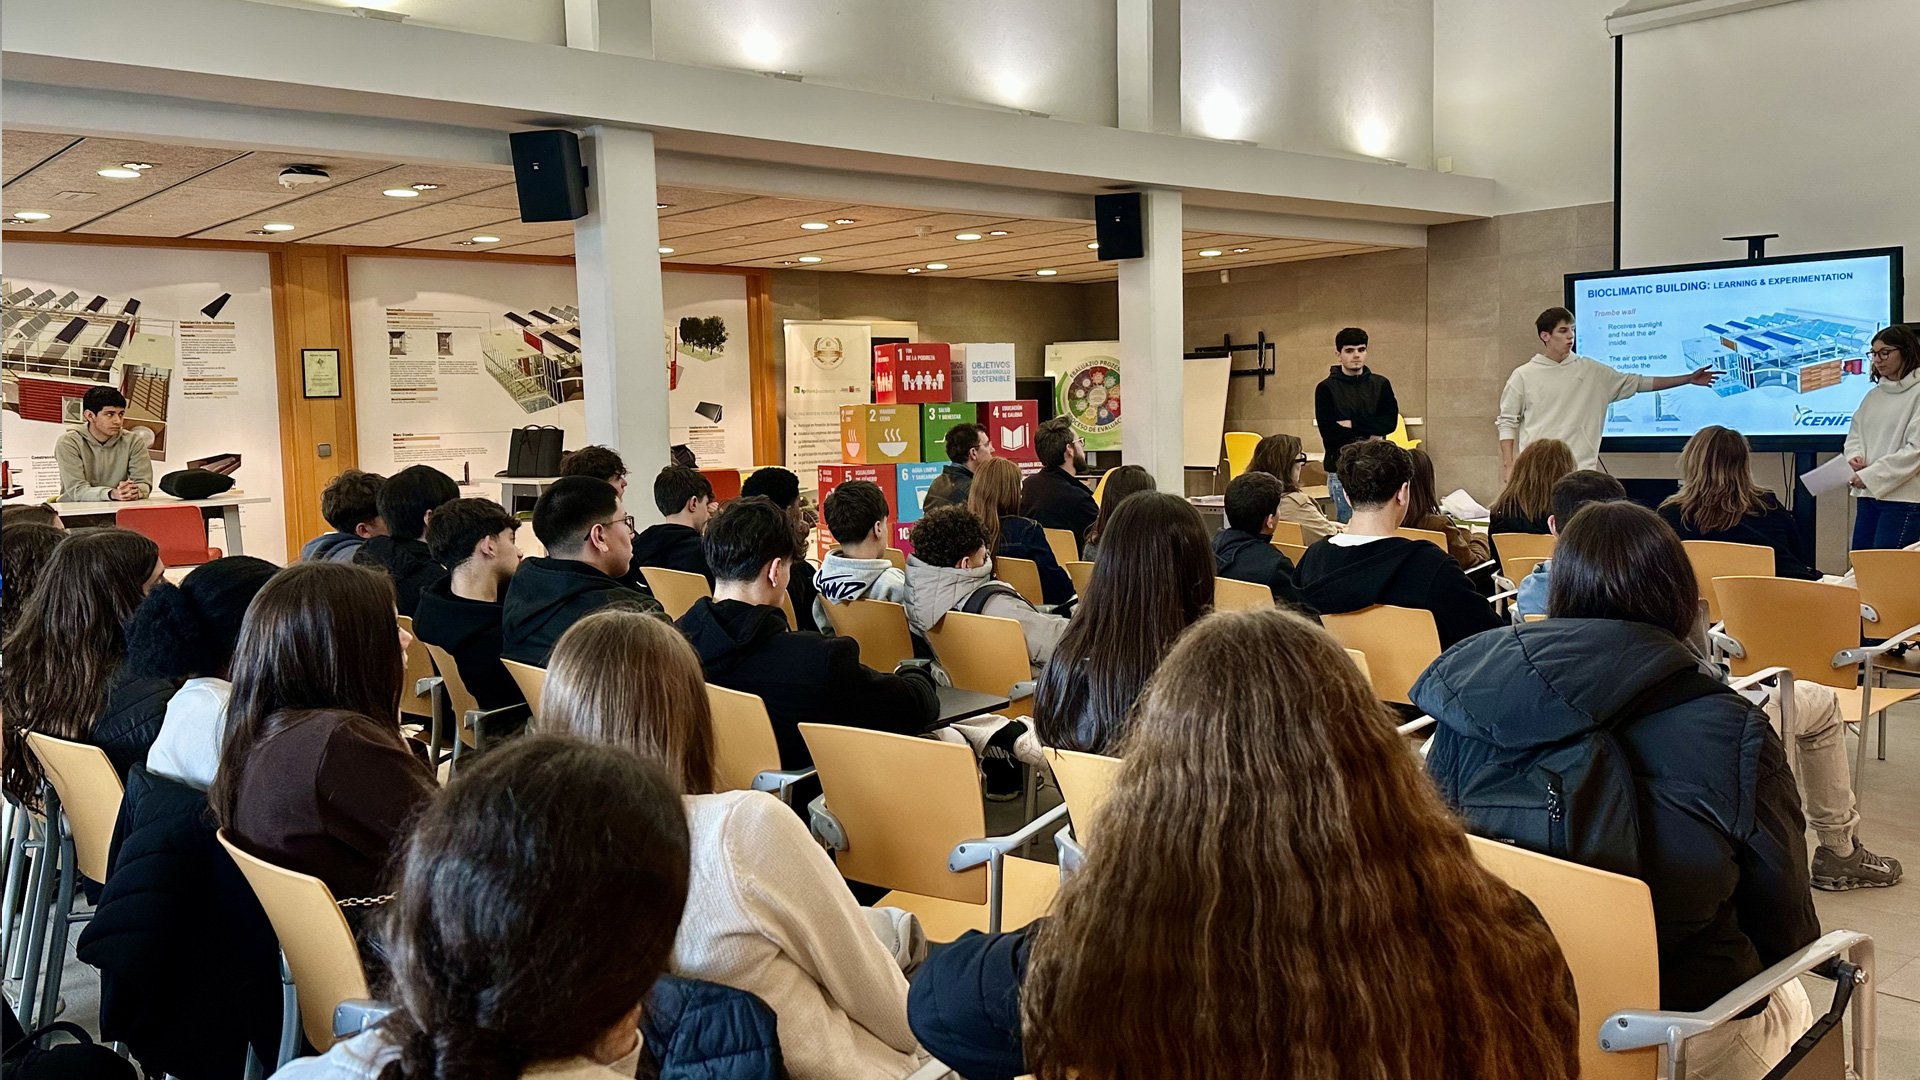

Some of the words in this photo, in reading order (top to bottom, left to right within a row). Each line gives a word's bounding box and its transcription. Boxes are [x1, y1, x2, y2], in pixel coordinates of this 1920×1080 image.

[1587, 285, 1653, 299] BIOCLIMATIC
[1656, 280, 1712, 294] BUILDING:
[1713, 279, 1758, 290] LEARNING
[1760, 278, 1767, 286] &
[1768, 272, 1854, 286] EXPERIMENTATION
[1594, 309, 1621, 318] Trombe
[1621, 308, 1637, 316] wall
[1607, 323, 1637, 331] Receives
[1637, 320, 1663, 330] sunlight
[1608, 330, 1620, 338] and
[1621, 330, 1636, 338] heat
[1636, 330, 1647, 338] the
[897, 347, 903, 362] 1
[1609, 355, 1621, 363] The
[1621, 354, 1631, 362] air
[1631, 354, 1647, 363] goes
[1648, 353, 1668, 361] inside
[971, 360, 1011, 370] OBJETIVOS
[1069, 359, 1099, 379] EBALUAZIO
[1616, 362, 1640, 370] outside
[1640, 361, 1651, 369] the
[972, 375, 1011, 383] SOSTENIBLE
[869, 408, 877, 422] 2
[928, 407, 936, 421] 3
[992, 405, 1000, 419] 4
[1607, 426, 1625, 434] Winter
[845, 470, 853, 483] 5
[901, 468, 909, 481] 6
